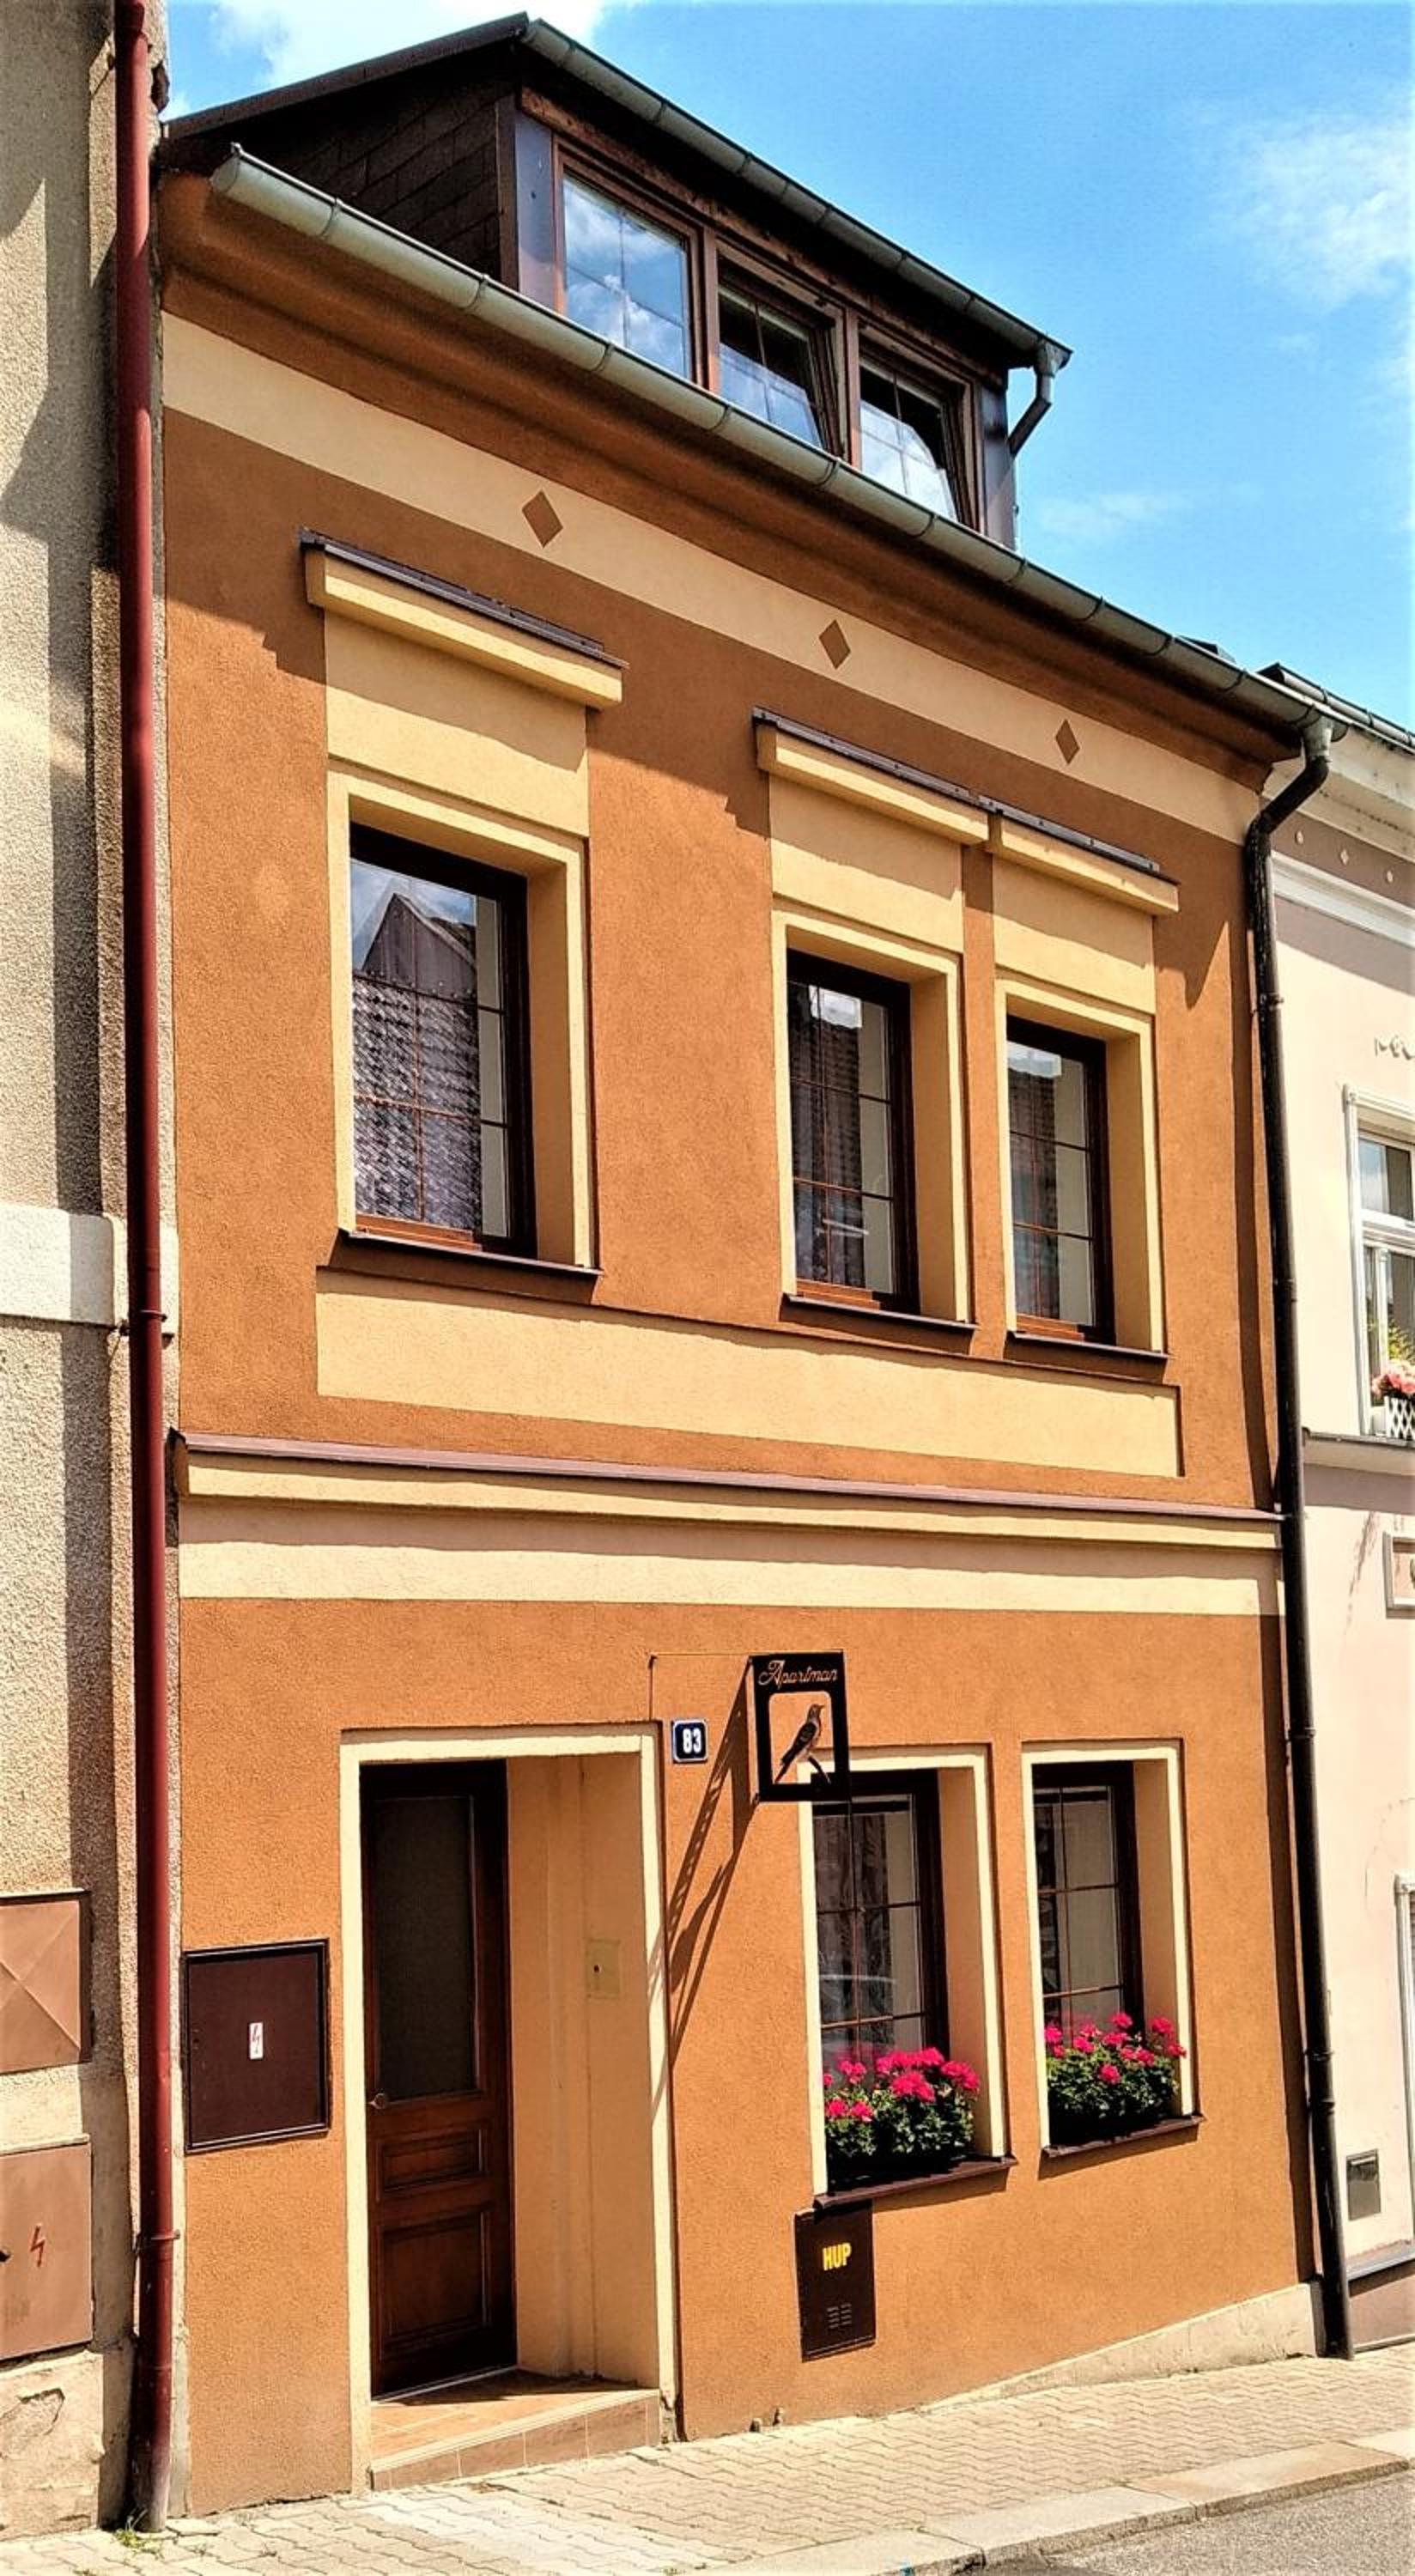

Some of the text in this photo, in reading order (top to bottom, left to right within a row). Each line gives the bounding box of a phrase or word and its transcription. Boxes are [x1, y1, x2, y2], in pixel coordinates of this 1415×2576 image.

[757, 1660, 838, 1689] Apartman
[682, 1728, 702, 1754] 83
[822, 2242, 853, 2272] HUP
